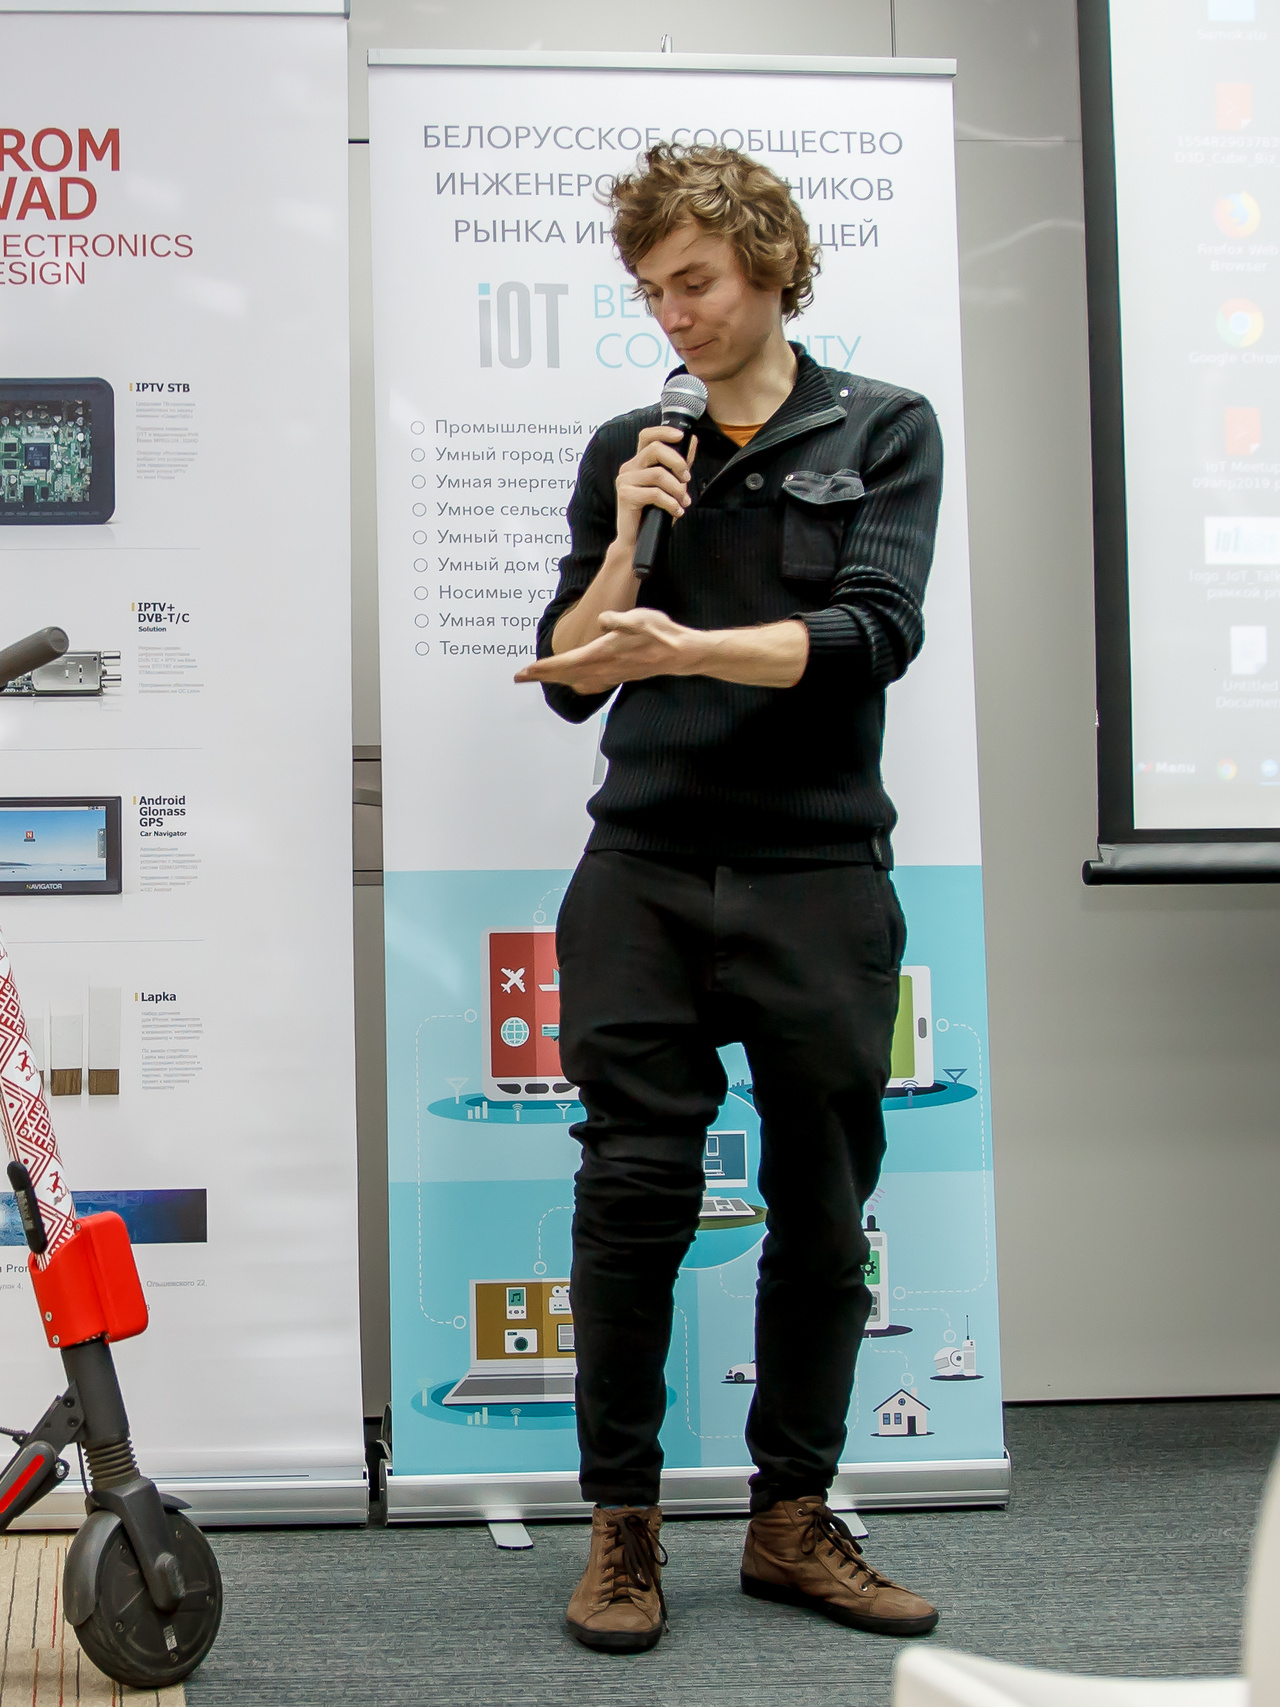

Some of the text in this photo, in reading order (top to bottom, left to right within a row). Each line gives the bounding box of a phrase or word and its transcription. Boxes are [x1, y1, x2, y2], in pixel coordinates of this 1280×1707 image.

[422, 125, 903, 158] БЕЛОРУССКОЕ СООБЩЕСТВО
[435, 172, 895, 201] ИНЖЕНЕРО НИКОВ
[454, 218, 880, 252] РЫНКА ИН ЩЕЙ
[135, 382, 191, 393] IPTV STB
[435, 419, 583, 438] Промышленный
[435, 447, 496, 462] Умный
[502, 450, 555, 465] город
[436, 474, 577, 493] Умная энергети
[436, 502, 568, 518] Умное сельско
[437, 529, 573, 547] Умный транспо
[438, 557, 499, 572] Умный
[504, 560, 540, 573] дом
[439, 585, 554, 604] Носимые уст
[137, 602, 176, 613] IPTV+
[137, 613, 190, 625] DVB-T/C
[439, 612, 540, 632] Умная торг
[439, 640, 537, 658] Телемедиц
[139, 795, 186, 806] Android
[139, 806, 186, 817] Glonass
[139, 817, 164, 828] GPS
[153, 830, 188, 839] Navigator
[26, 883, 63, 891] NAVIGATOR
[141, 992, 177, 1004] Lapka
